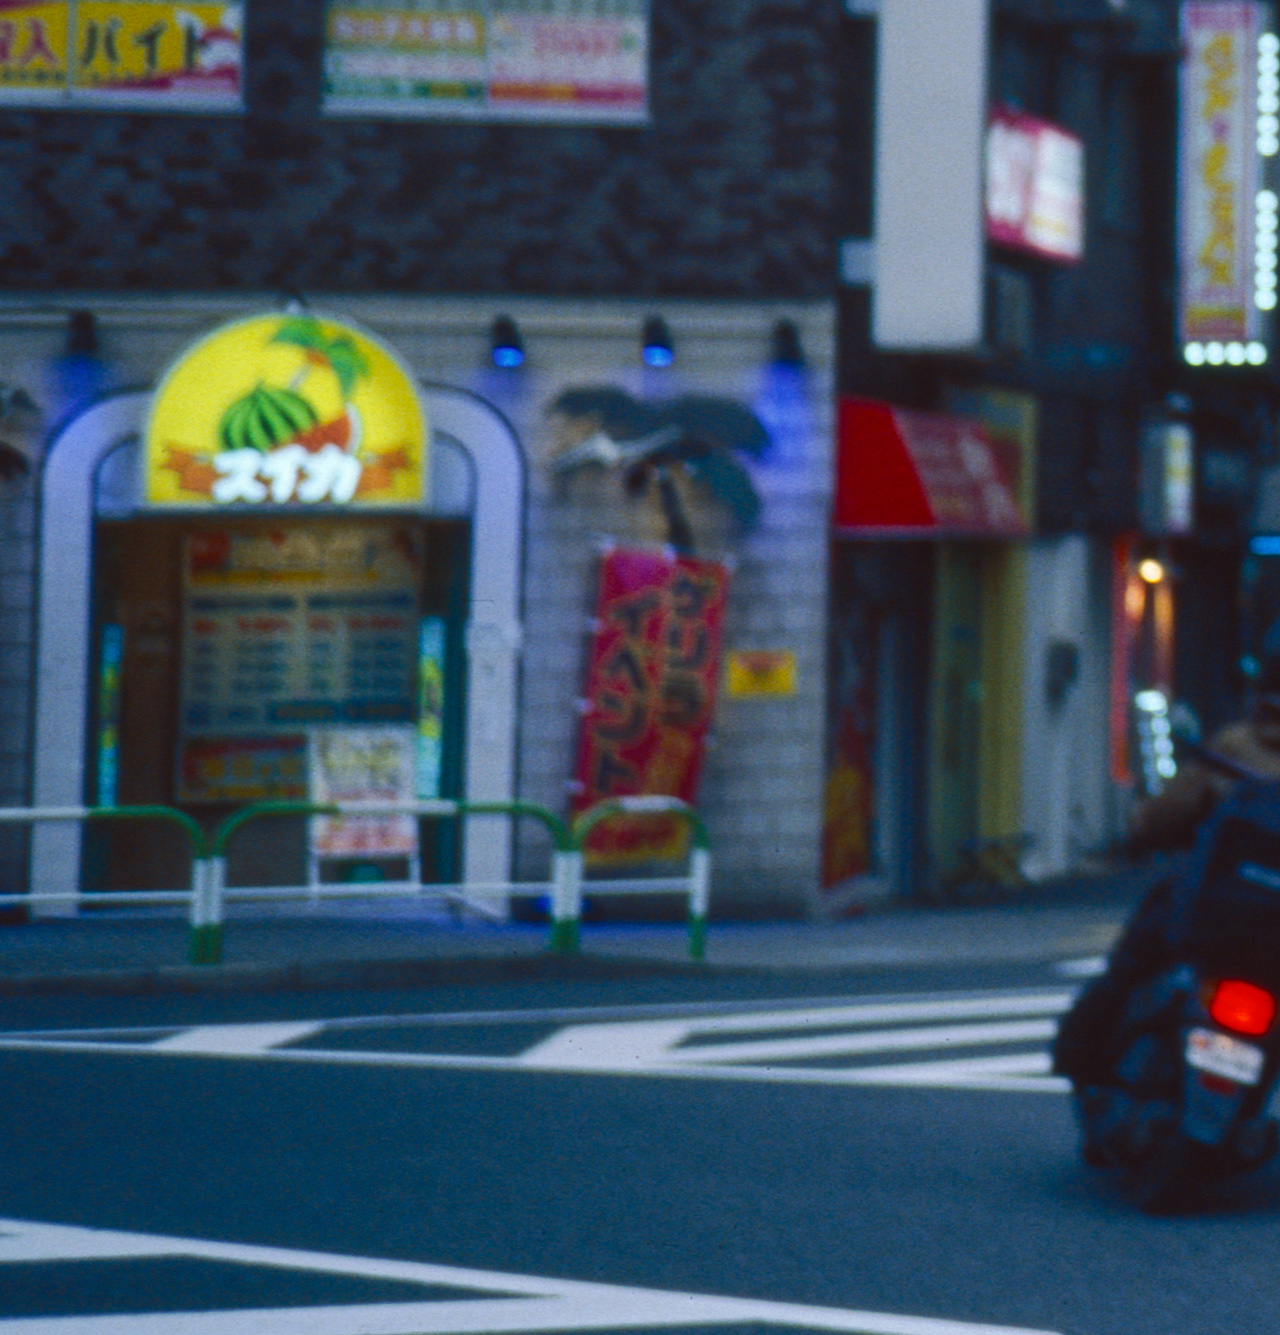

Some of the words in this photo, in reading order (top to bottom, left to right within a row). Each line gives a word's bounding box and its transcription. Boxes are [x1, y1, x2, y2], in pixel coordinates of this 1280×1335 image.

[81, 17, 212, 75] バイト
[211, 442, 363, 504] スイカ
